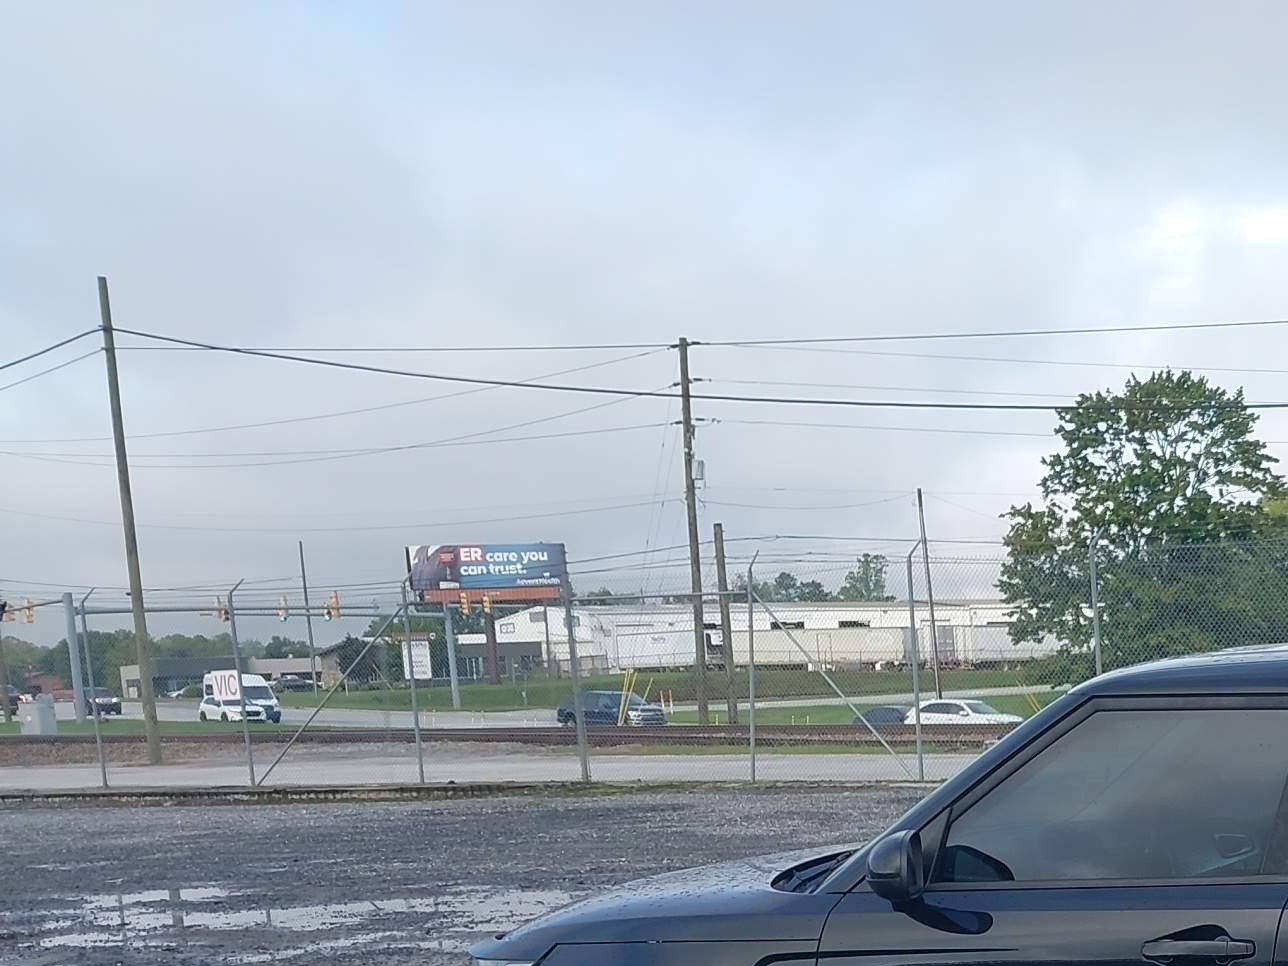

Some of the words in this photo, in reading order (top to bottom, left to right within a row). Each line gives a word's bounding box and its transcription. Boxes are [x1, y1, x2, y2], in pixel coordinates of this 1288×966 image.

[460, 547, 482, 561] ER
[486, 552, 517, 562] care
[521, 551, 548, 564] you
[460, 565, 487, 575] can
[488, 563, 527, 575] trust.
[215, 674, 238, 696] VIC
